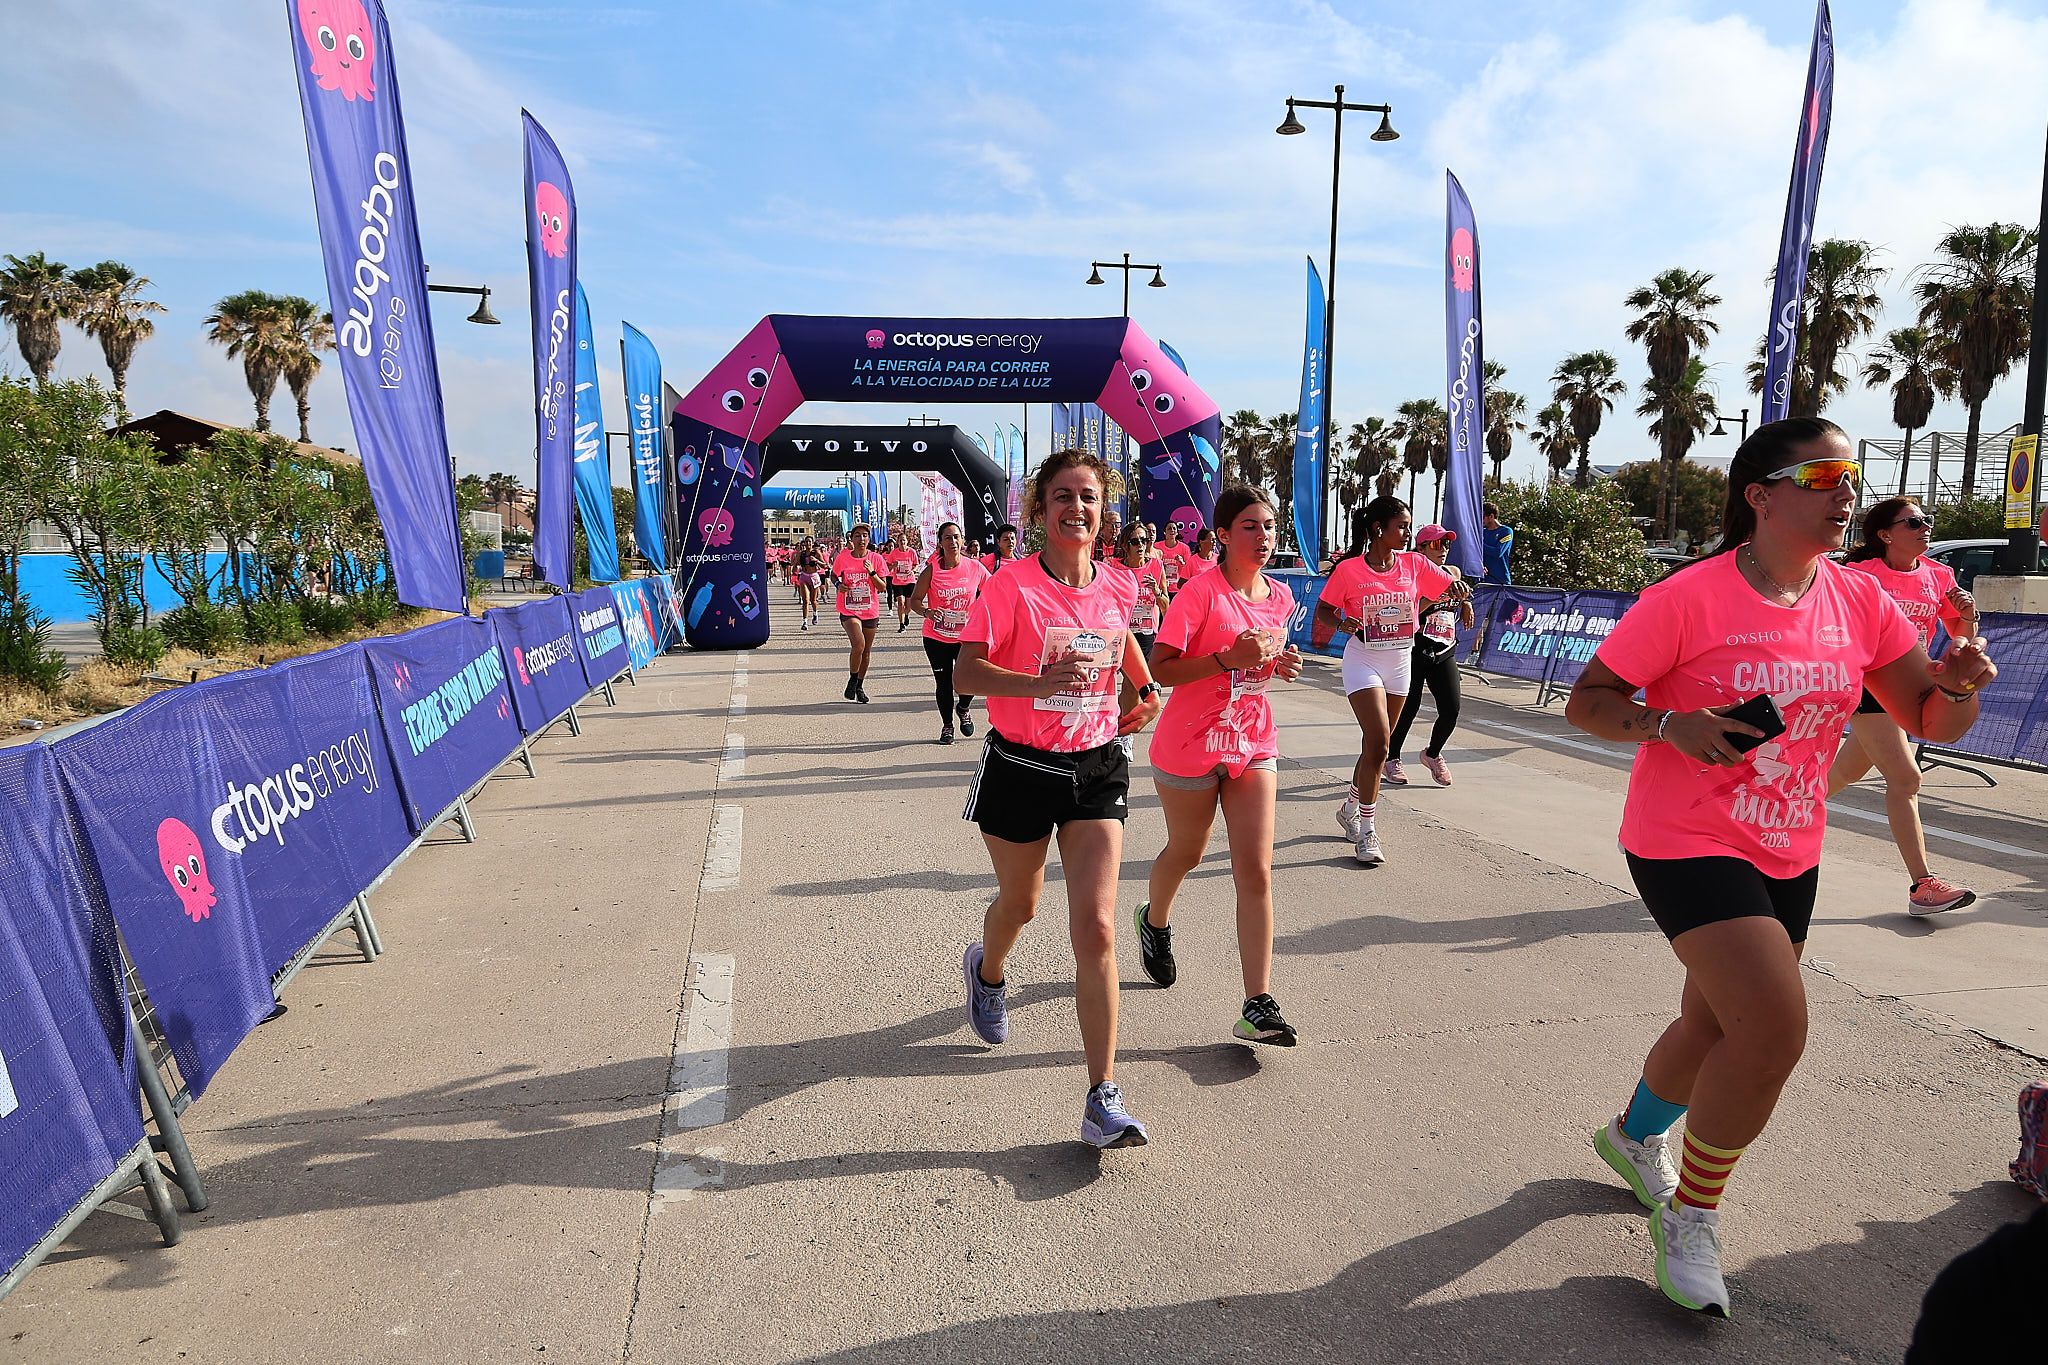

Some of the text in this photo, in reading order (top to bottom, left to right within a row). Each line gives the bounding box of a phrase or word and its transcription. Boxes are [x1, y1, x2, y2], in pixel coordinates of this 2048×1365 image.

[893, 331, 1043, 354] octopus energy
[854, 357, 1050, 374] LA ENERGÍA PARA CORRER
[852, 375, 1052, 388] A LA VELOCIDAD DE LA LUZ
[792, 439, 928, 453] VOLVO
[784, 489, 826, 508] Marlene
[686, 552, 754, 564] octopus energy
[1363, 591, 1412, 606] CARRERA
[1041, 617, 1079, 628] OYSHO
[1381, 624, 1399, 633] 016
[1436, 625, 1447, 633] 016
[1497, 630, 1535, 655] PARA
[1534, 634, 1556, 658] TU
[1726, 630, 1782, 646] OYSHO
[525, 642, 557, 677] octopus
[552, 632, 576, 663] energy
[1732, 661, 1853, 693] CARRERA
[1044, 699, 1074, 708] OYSHO
[307, 728, 379, 799] energy
[1220, 753, 1241, 764] 2026
[1730, 794, 1816, 829] MUJER
[1760, 832, 1791, 848] 2026
